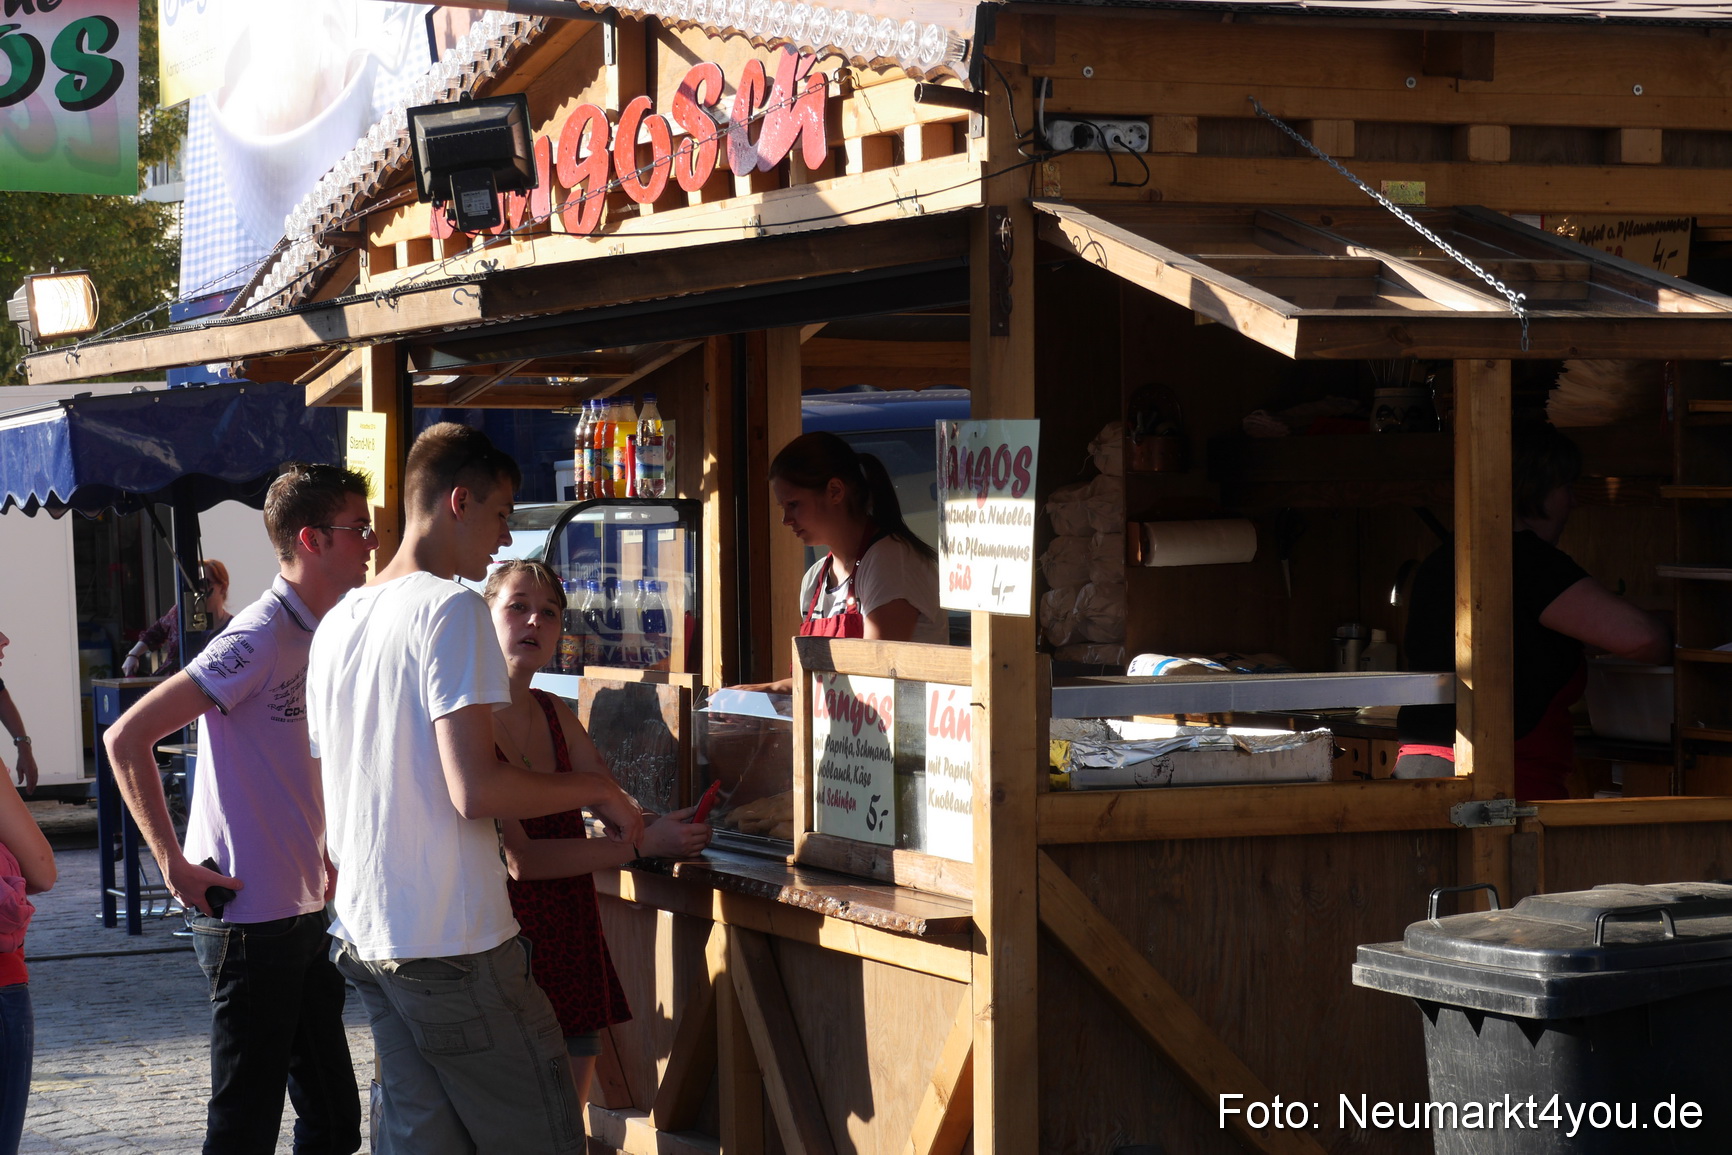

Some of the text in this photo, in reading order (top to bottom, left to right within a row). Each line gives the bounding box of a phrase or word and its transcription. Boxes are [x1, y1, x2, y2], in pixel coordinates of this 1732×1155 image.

[430, 44, 828, 239] ngosch
[1579, 224, 1605, 246] Apfel
[1617, 217, 1690, 242] Pflaumenmus
[988, 505, 1032, 527] Nutella
[965, 536, 1030, 562] Pflaumenmus
[949, 562, 972, 593] süß
[813, 673, 893, 737] Lángos
[815, 732, 894, 765] mit Paprika, Schmand,
[853, 761, 871, 789] Käse
[928, 755, 941, 776] mit
[826, 788, 857, 814] Schinken
